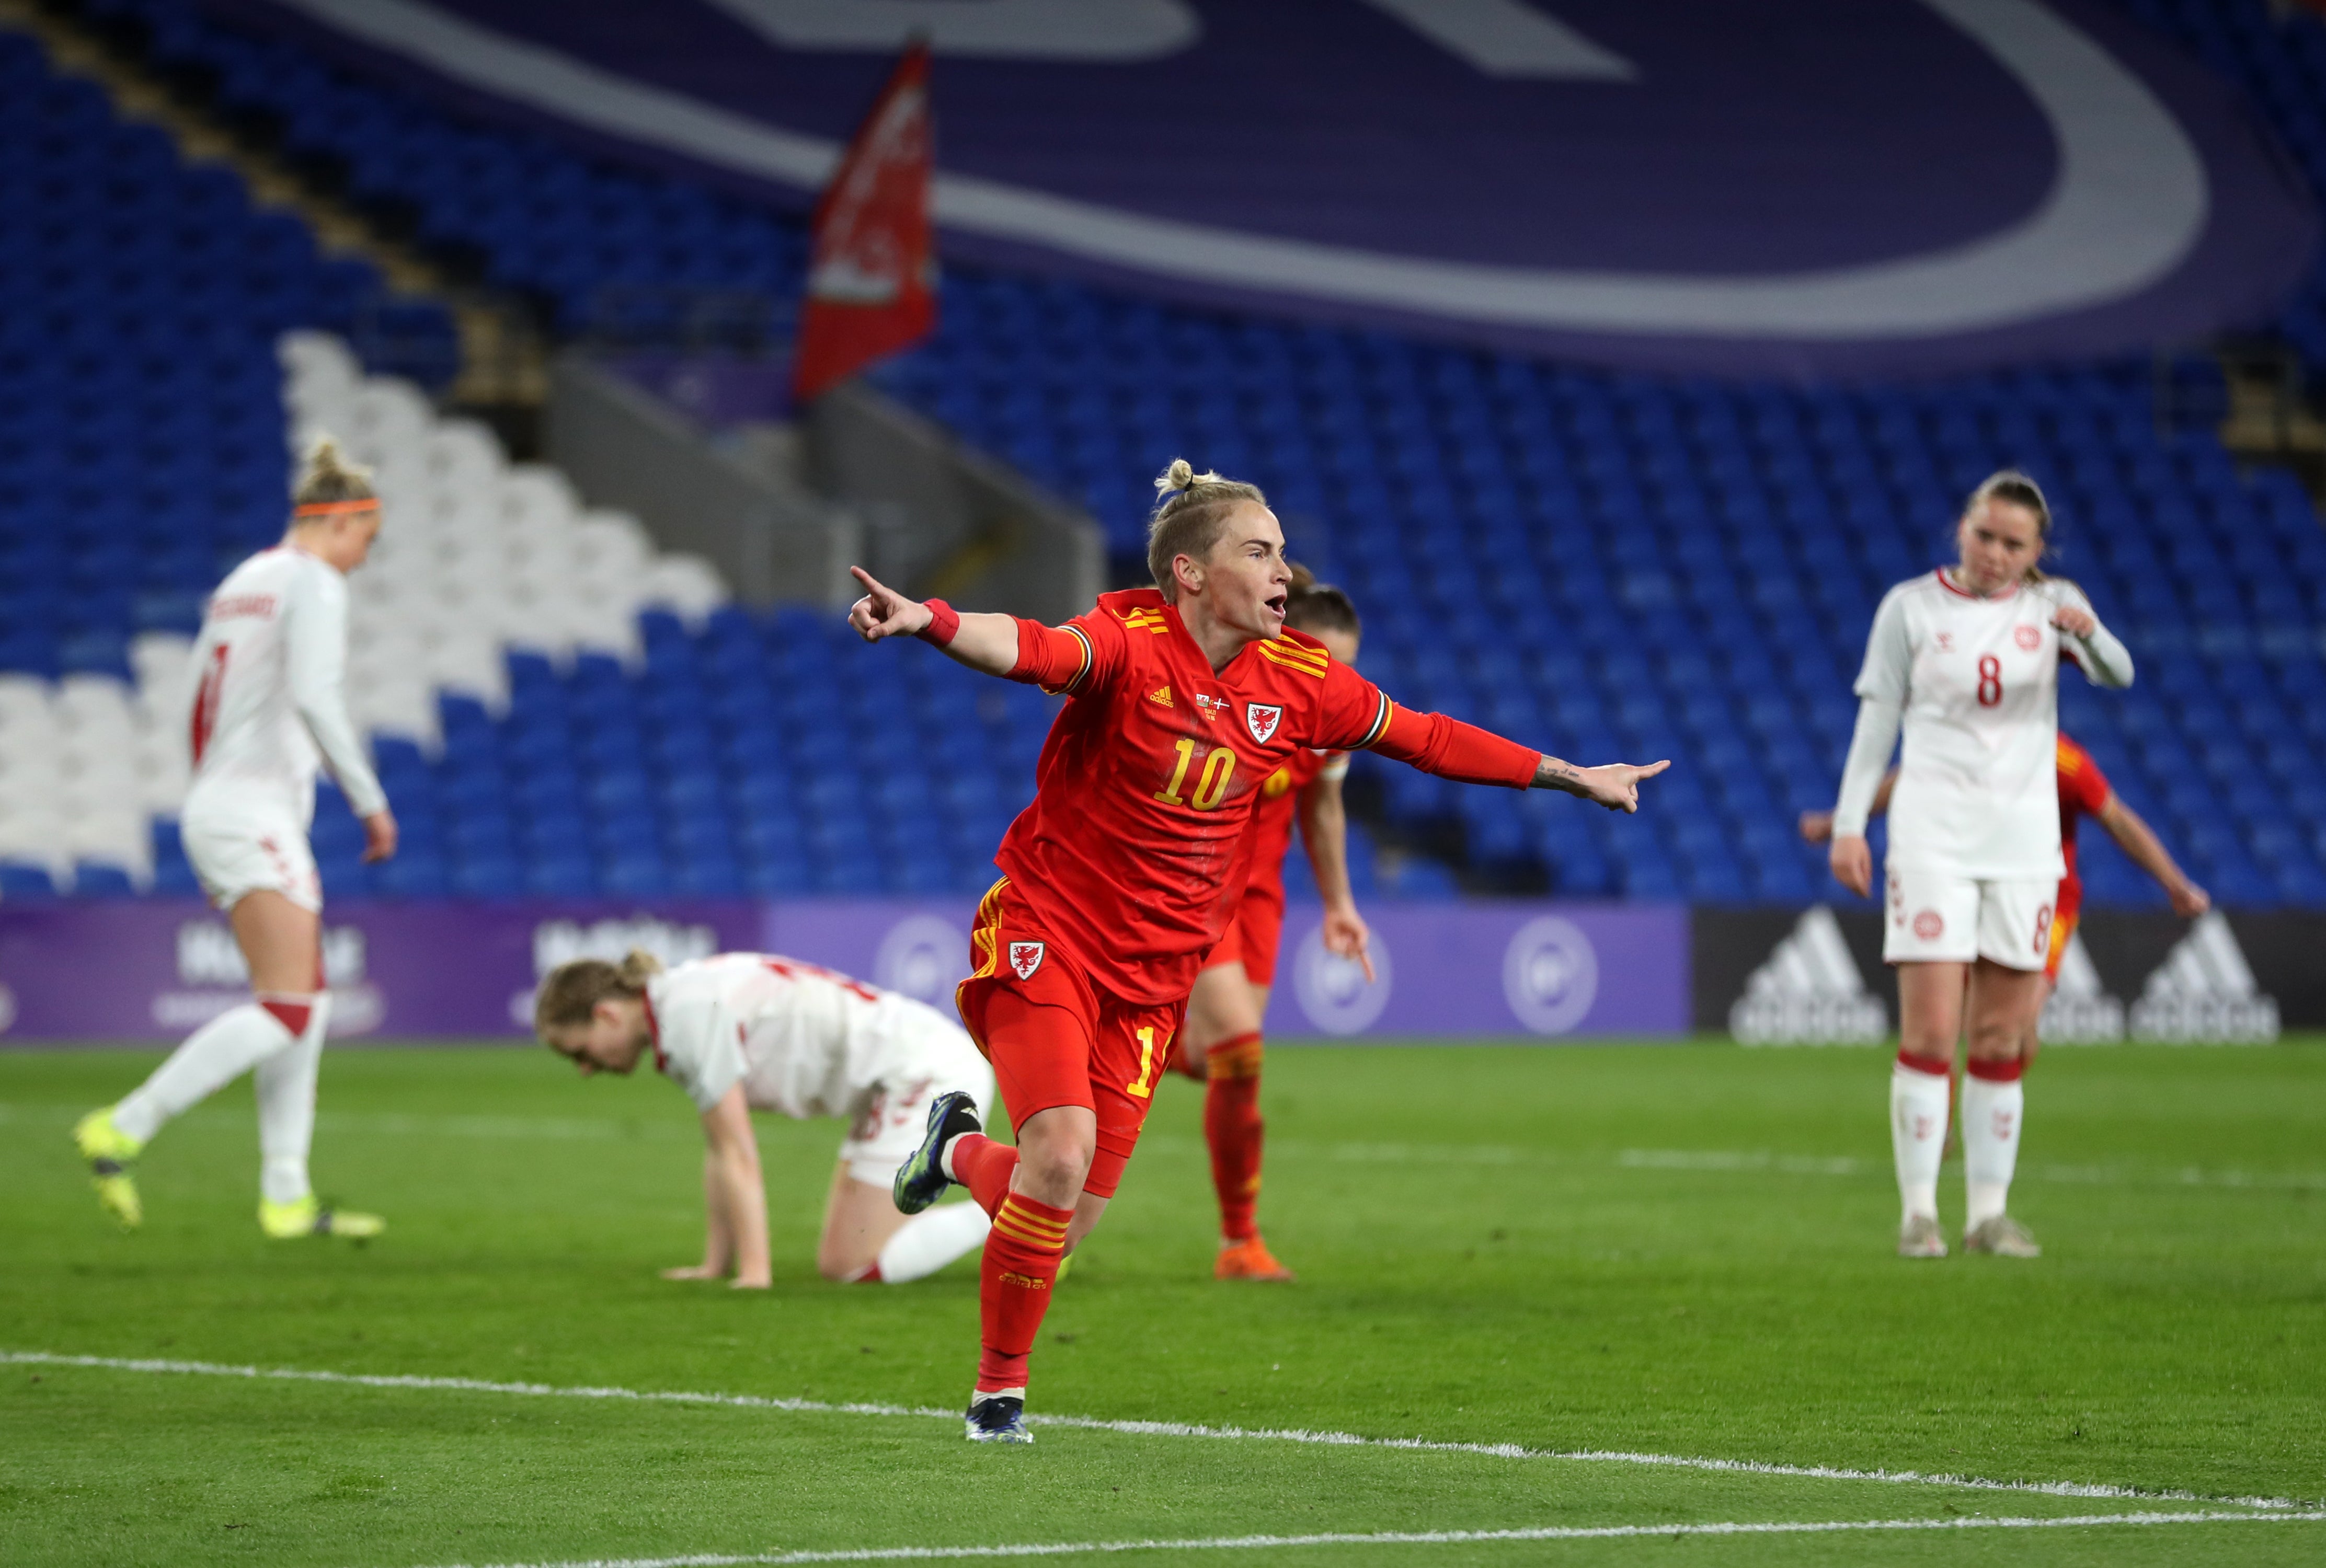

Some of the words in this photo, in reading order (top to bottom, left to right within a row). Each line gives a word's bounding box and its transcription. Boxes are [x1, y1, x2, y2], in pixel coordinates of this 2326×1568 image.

[1150, 695, 1174, 708] adidas
[1978, 653, 2002, 709] 8
[1153, 739, 1236, 811] 10
[2033, 903, 2052, 955] 8
[1127, 1027, 1174, 1099] 1
